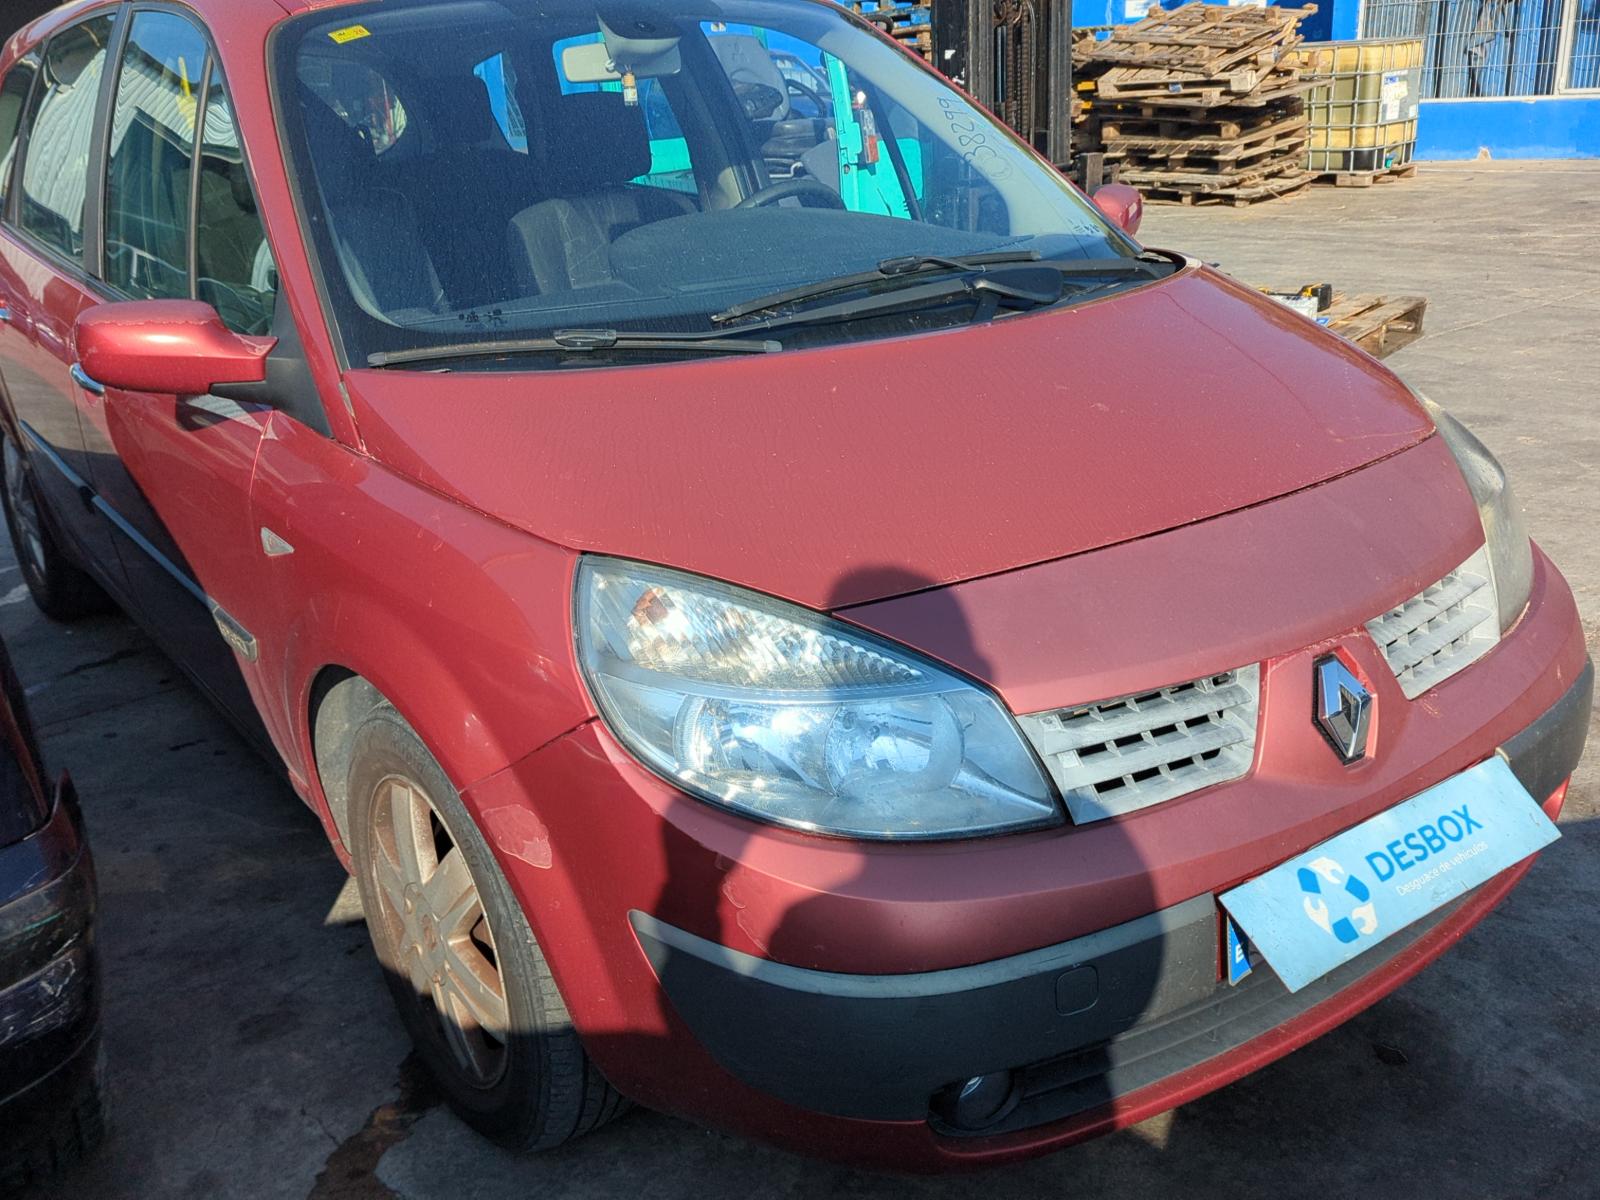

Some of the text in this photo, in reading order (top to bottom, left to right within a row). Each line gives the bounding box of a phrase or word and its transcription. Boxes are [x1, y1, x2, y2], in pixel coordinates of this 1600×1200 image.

[1365, 805, 1482, 882] DESBOX
[1396, 867, 1440, 896] Desguace
[1438, 860, 1453, 874] de
